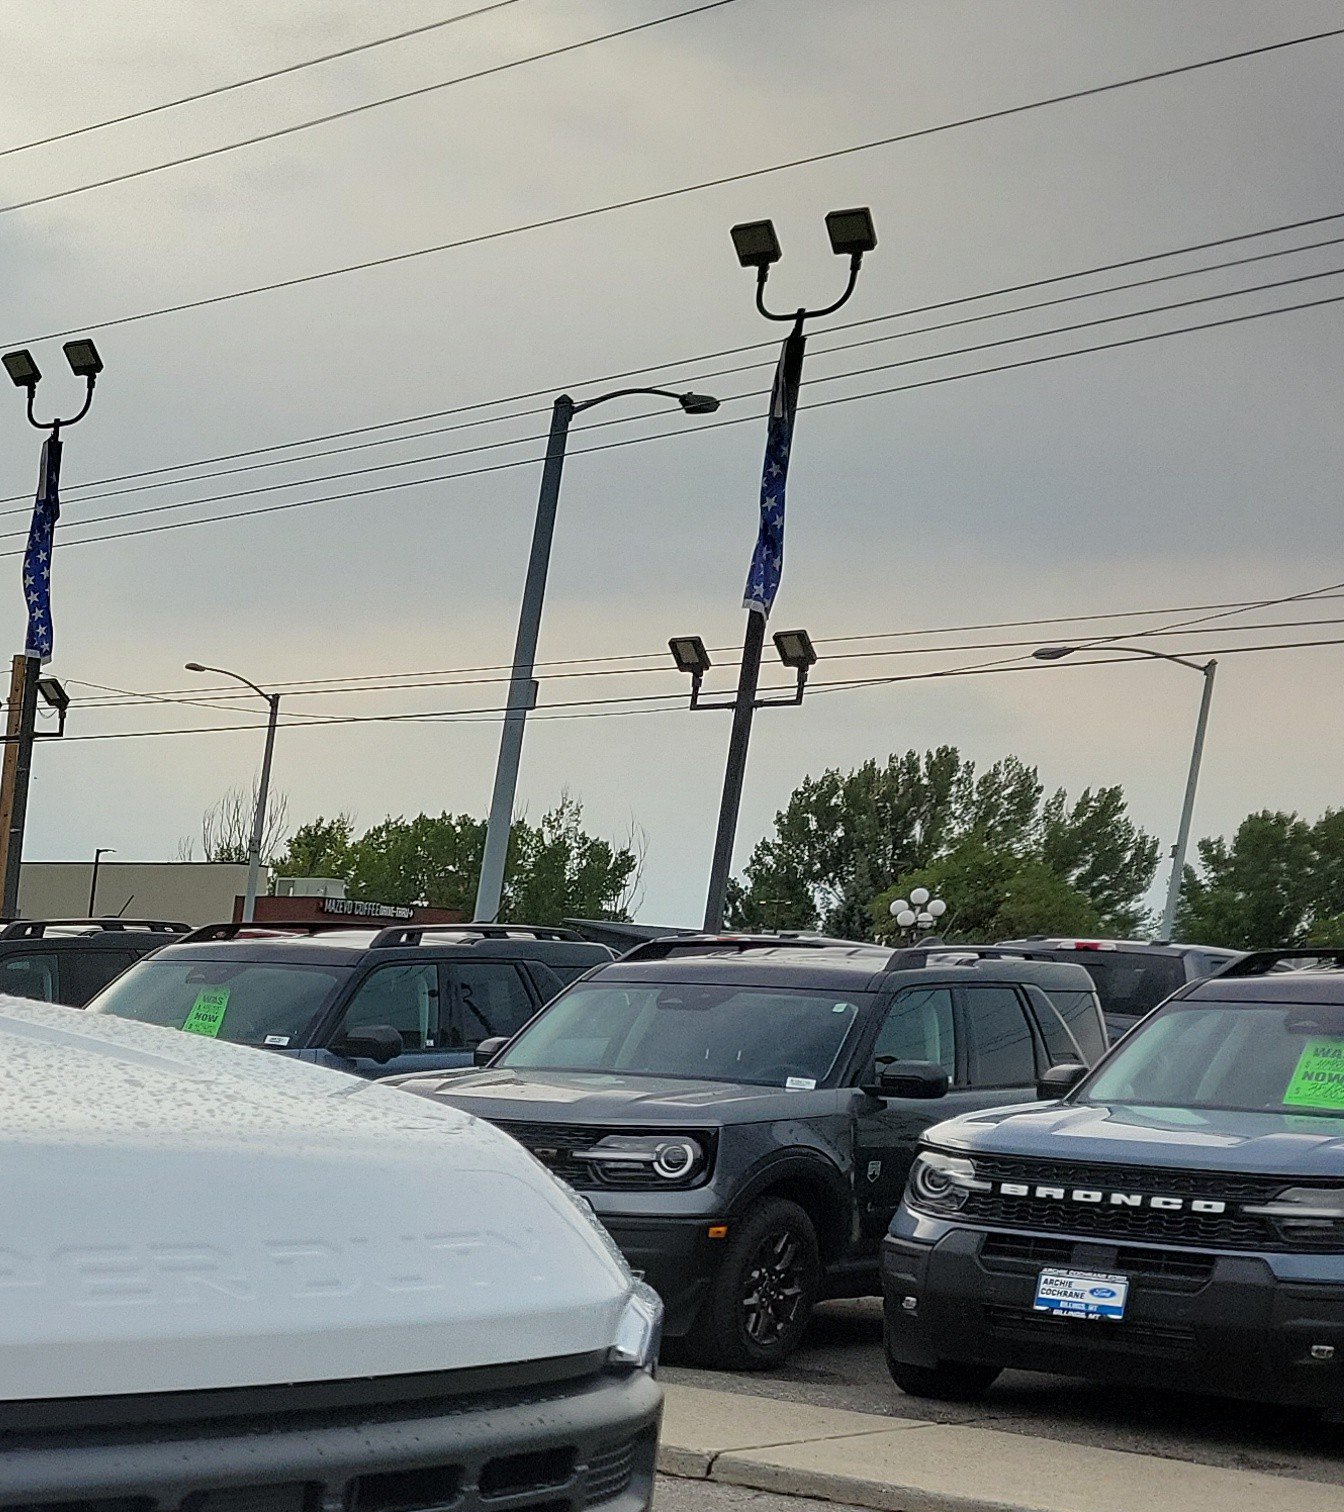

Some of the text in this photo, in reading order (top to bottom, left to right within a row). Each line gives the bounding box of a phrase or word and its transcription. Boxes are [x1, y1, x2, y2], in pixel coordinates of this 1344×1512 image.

[354, 901, 380, 916] COFFEE
[194, 1012, 219, 1023] NOW
[1313, 1046, 1344, 1059] WA
[999, 1183, 1226, 1213] BRONCO
[260, 1226, 546, 1300] DUTY
[1042, 1279, 1073, 1289] ARCHIE
[1040, 1287, 1086, 1300] COCHRANE
